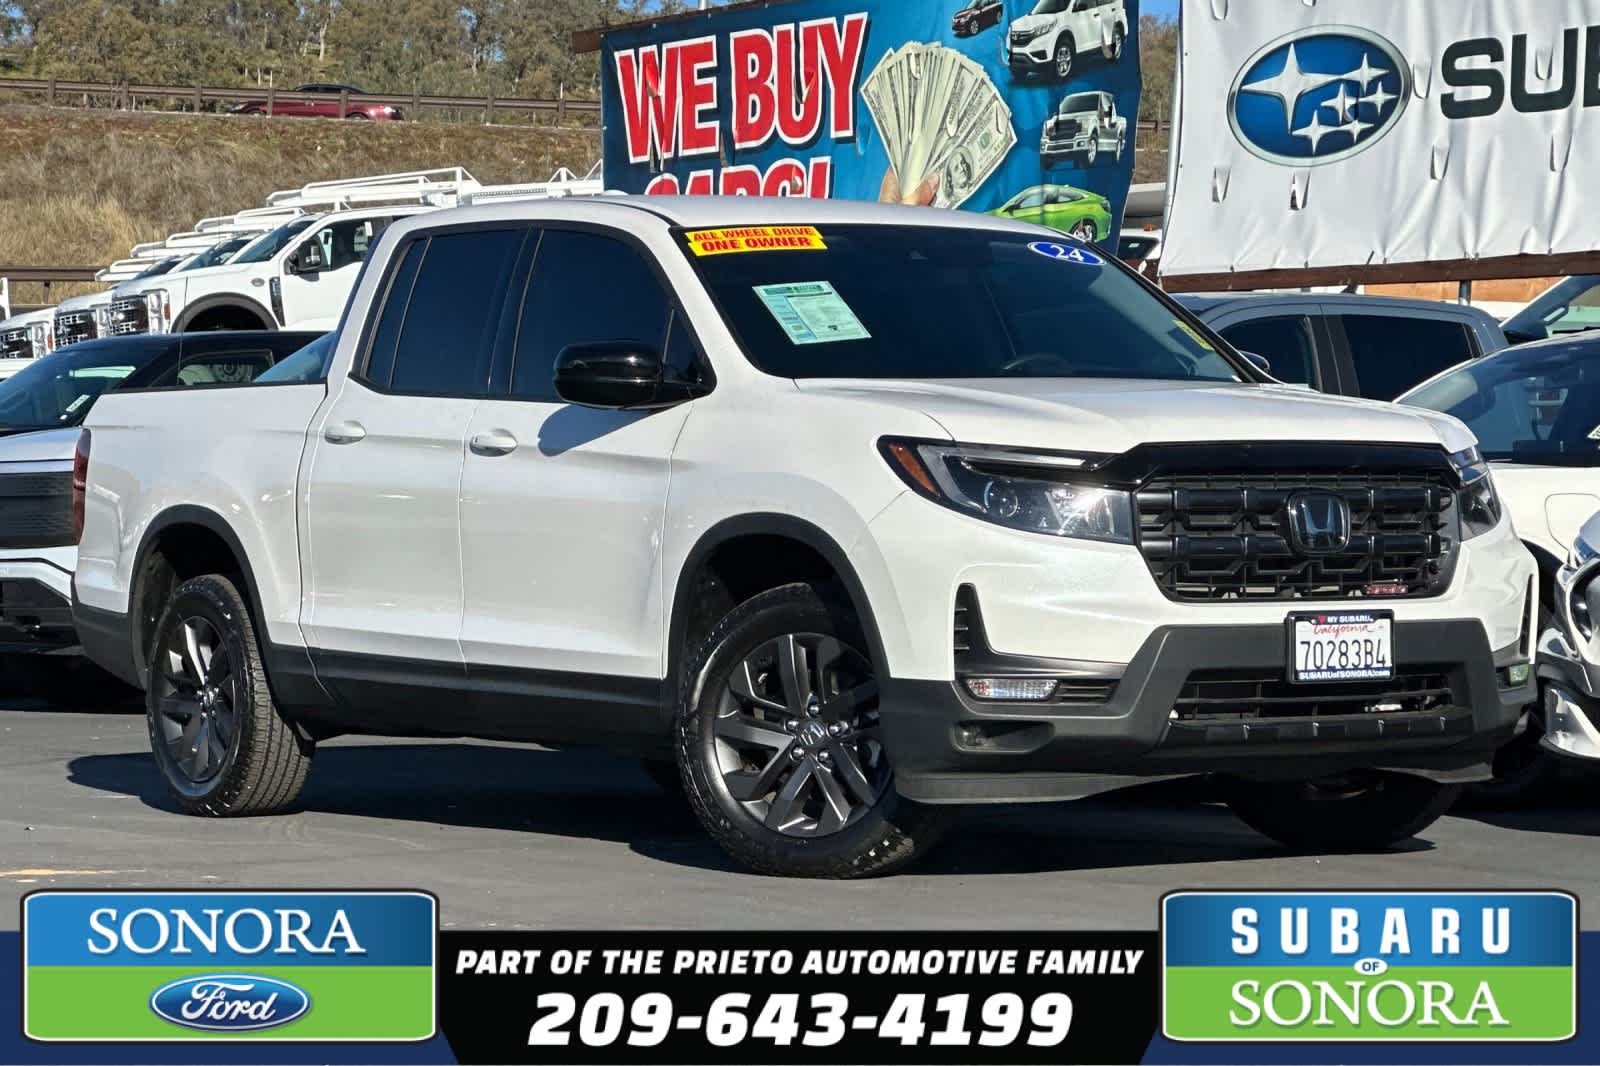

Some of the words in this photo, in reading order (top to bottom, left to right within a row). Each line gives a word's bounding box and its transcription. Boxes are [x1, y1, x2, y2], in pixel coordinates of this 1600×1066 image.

[1441, 25, 1600, 119] SU
[614, 35, 720, 164] WE
[730, 12, 868, 150] BUY
[693, 232, 719, 241] ALL
[721, 228, 769, 239] WHEEL
[772, 226, 814, 236] DRIVE
[701, 239, 741, 252] ONE
[744, 237, 811, 248] OWNER
[1050, 244, 1084, 262] 24
[1327, 615, 1338, 623] MY
[1313, 624, 1369, 639] California
[1300, 639, 1386, 669] 70283B4
